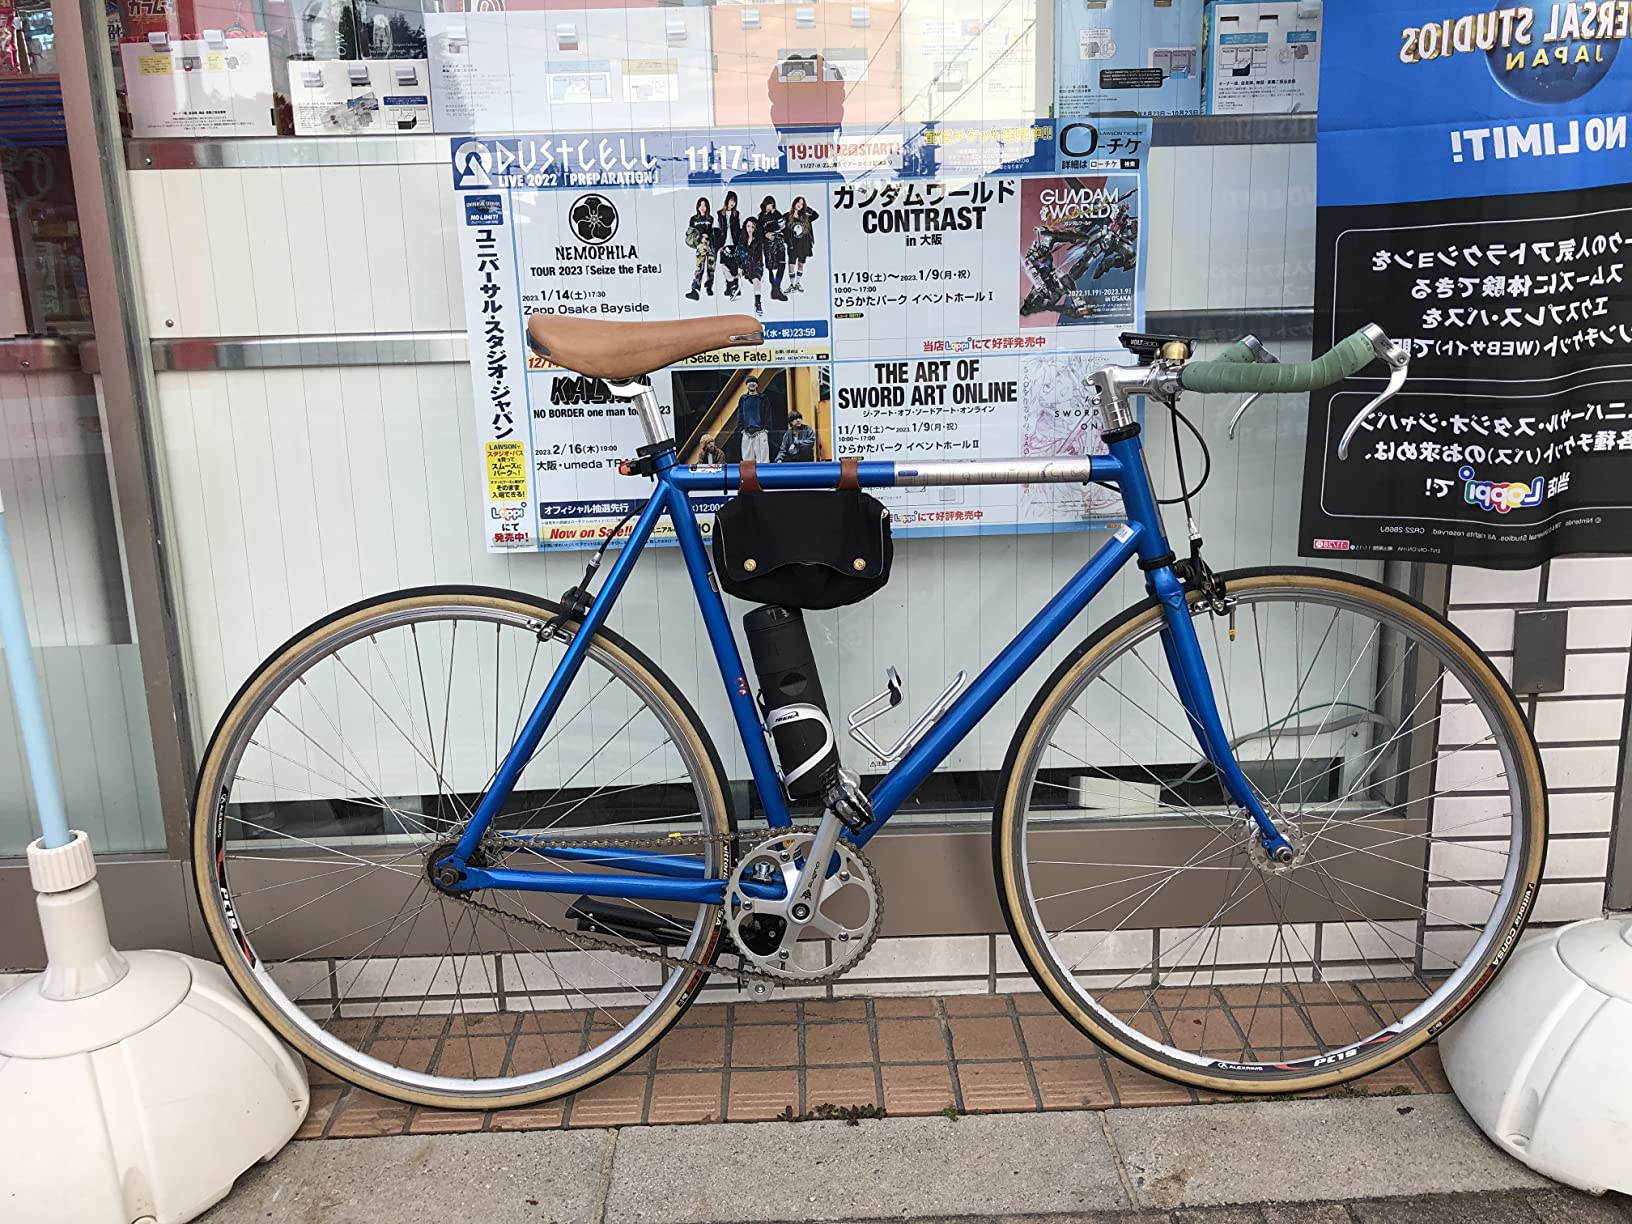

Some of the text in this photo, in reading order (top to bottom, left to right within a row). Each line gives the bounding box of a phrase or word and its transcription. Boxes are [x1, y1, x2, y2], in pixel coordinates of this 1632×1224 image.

[752, 153, 780, 170] Thu
[500, 175, 525, 188] LIVE
[527, 173, 558, 187] 2022
[834, 179, 1015, 209] ガンダムワールド
[1040, 188, 1119, 205] GUNDAM
[863, 207, 986, 234] CONTRAST
[906, 234, 943, 246] in 大阪
[555, 245, 639, 260] NEMOPHILA
[530, 266, 555, 276] TOUR
[558, 265, 583, 276] 2023
[619, 264, 634, 274] the
[558, 303, 597, 314] Osaka
[600, 302, 649, 315] Bayside
[834, 295, 907, 307] ひらかたパーク
[475, 229, 515, 439] ユニバーサル・スタジオ・ジャパン
[723, 352, 740, 362] the
[875, 359, 979, 383] THE ART OF
[838, 381, 1018, 410] SWORD ART ONLINE
[534, 410, 545, 418] NO
[549, 408, 584, 418] BORDER
[587, 409, 603, 417] one
[606, 408, 625, 416] man
[1055, 409, 1099, 417] SWORD
[838, 441, 903, 455] ひらかたパーク
[491, 501, 527, 521] Loppi
[544, 503, 629, 515] オフィシャル抽選先行
[502, 523, 519, 531] にて
[550, 528, 575, 540] Now
[580, 529, 594, 538] on
[1492, 927, 1517, 966] CORSA
[1313, 1048, 1357, 1067] PC19
